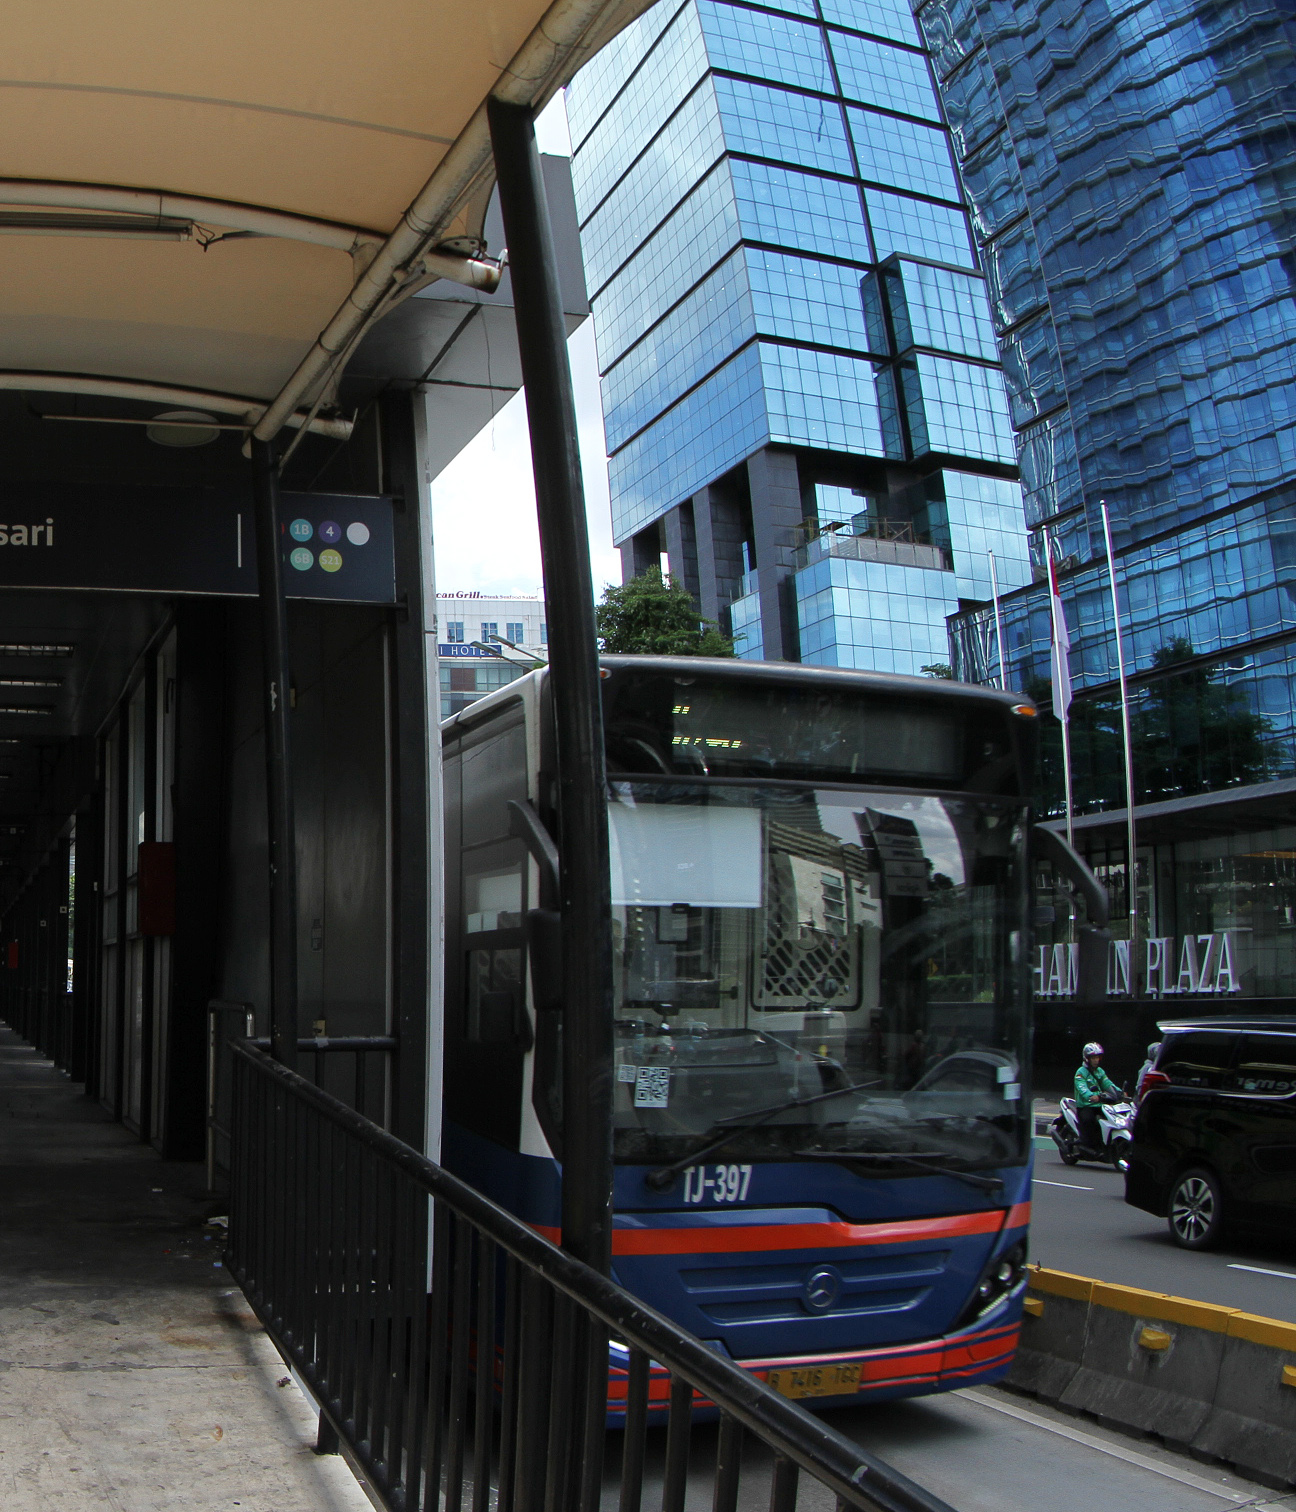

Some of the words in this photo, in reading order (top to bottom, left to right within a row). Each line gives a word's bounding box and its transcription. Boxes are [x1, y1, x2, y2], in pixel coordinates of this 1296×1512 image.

[294, 524, 310, 536] 1B
[325, 526, 334, 537] 4
[294, 553, 310, 564] 6B
[321, 556, 340, 565] S21
[1145, 933, 1242, 994] PLAZA
[683, 1164, 753, 1203] TJ-397
